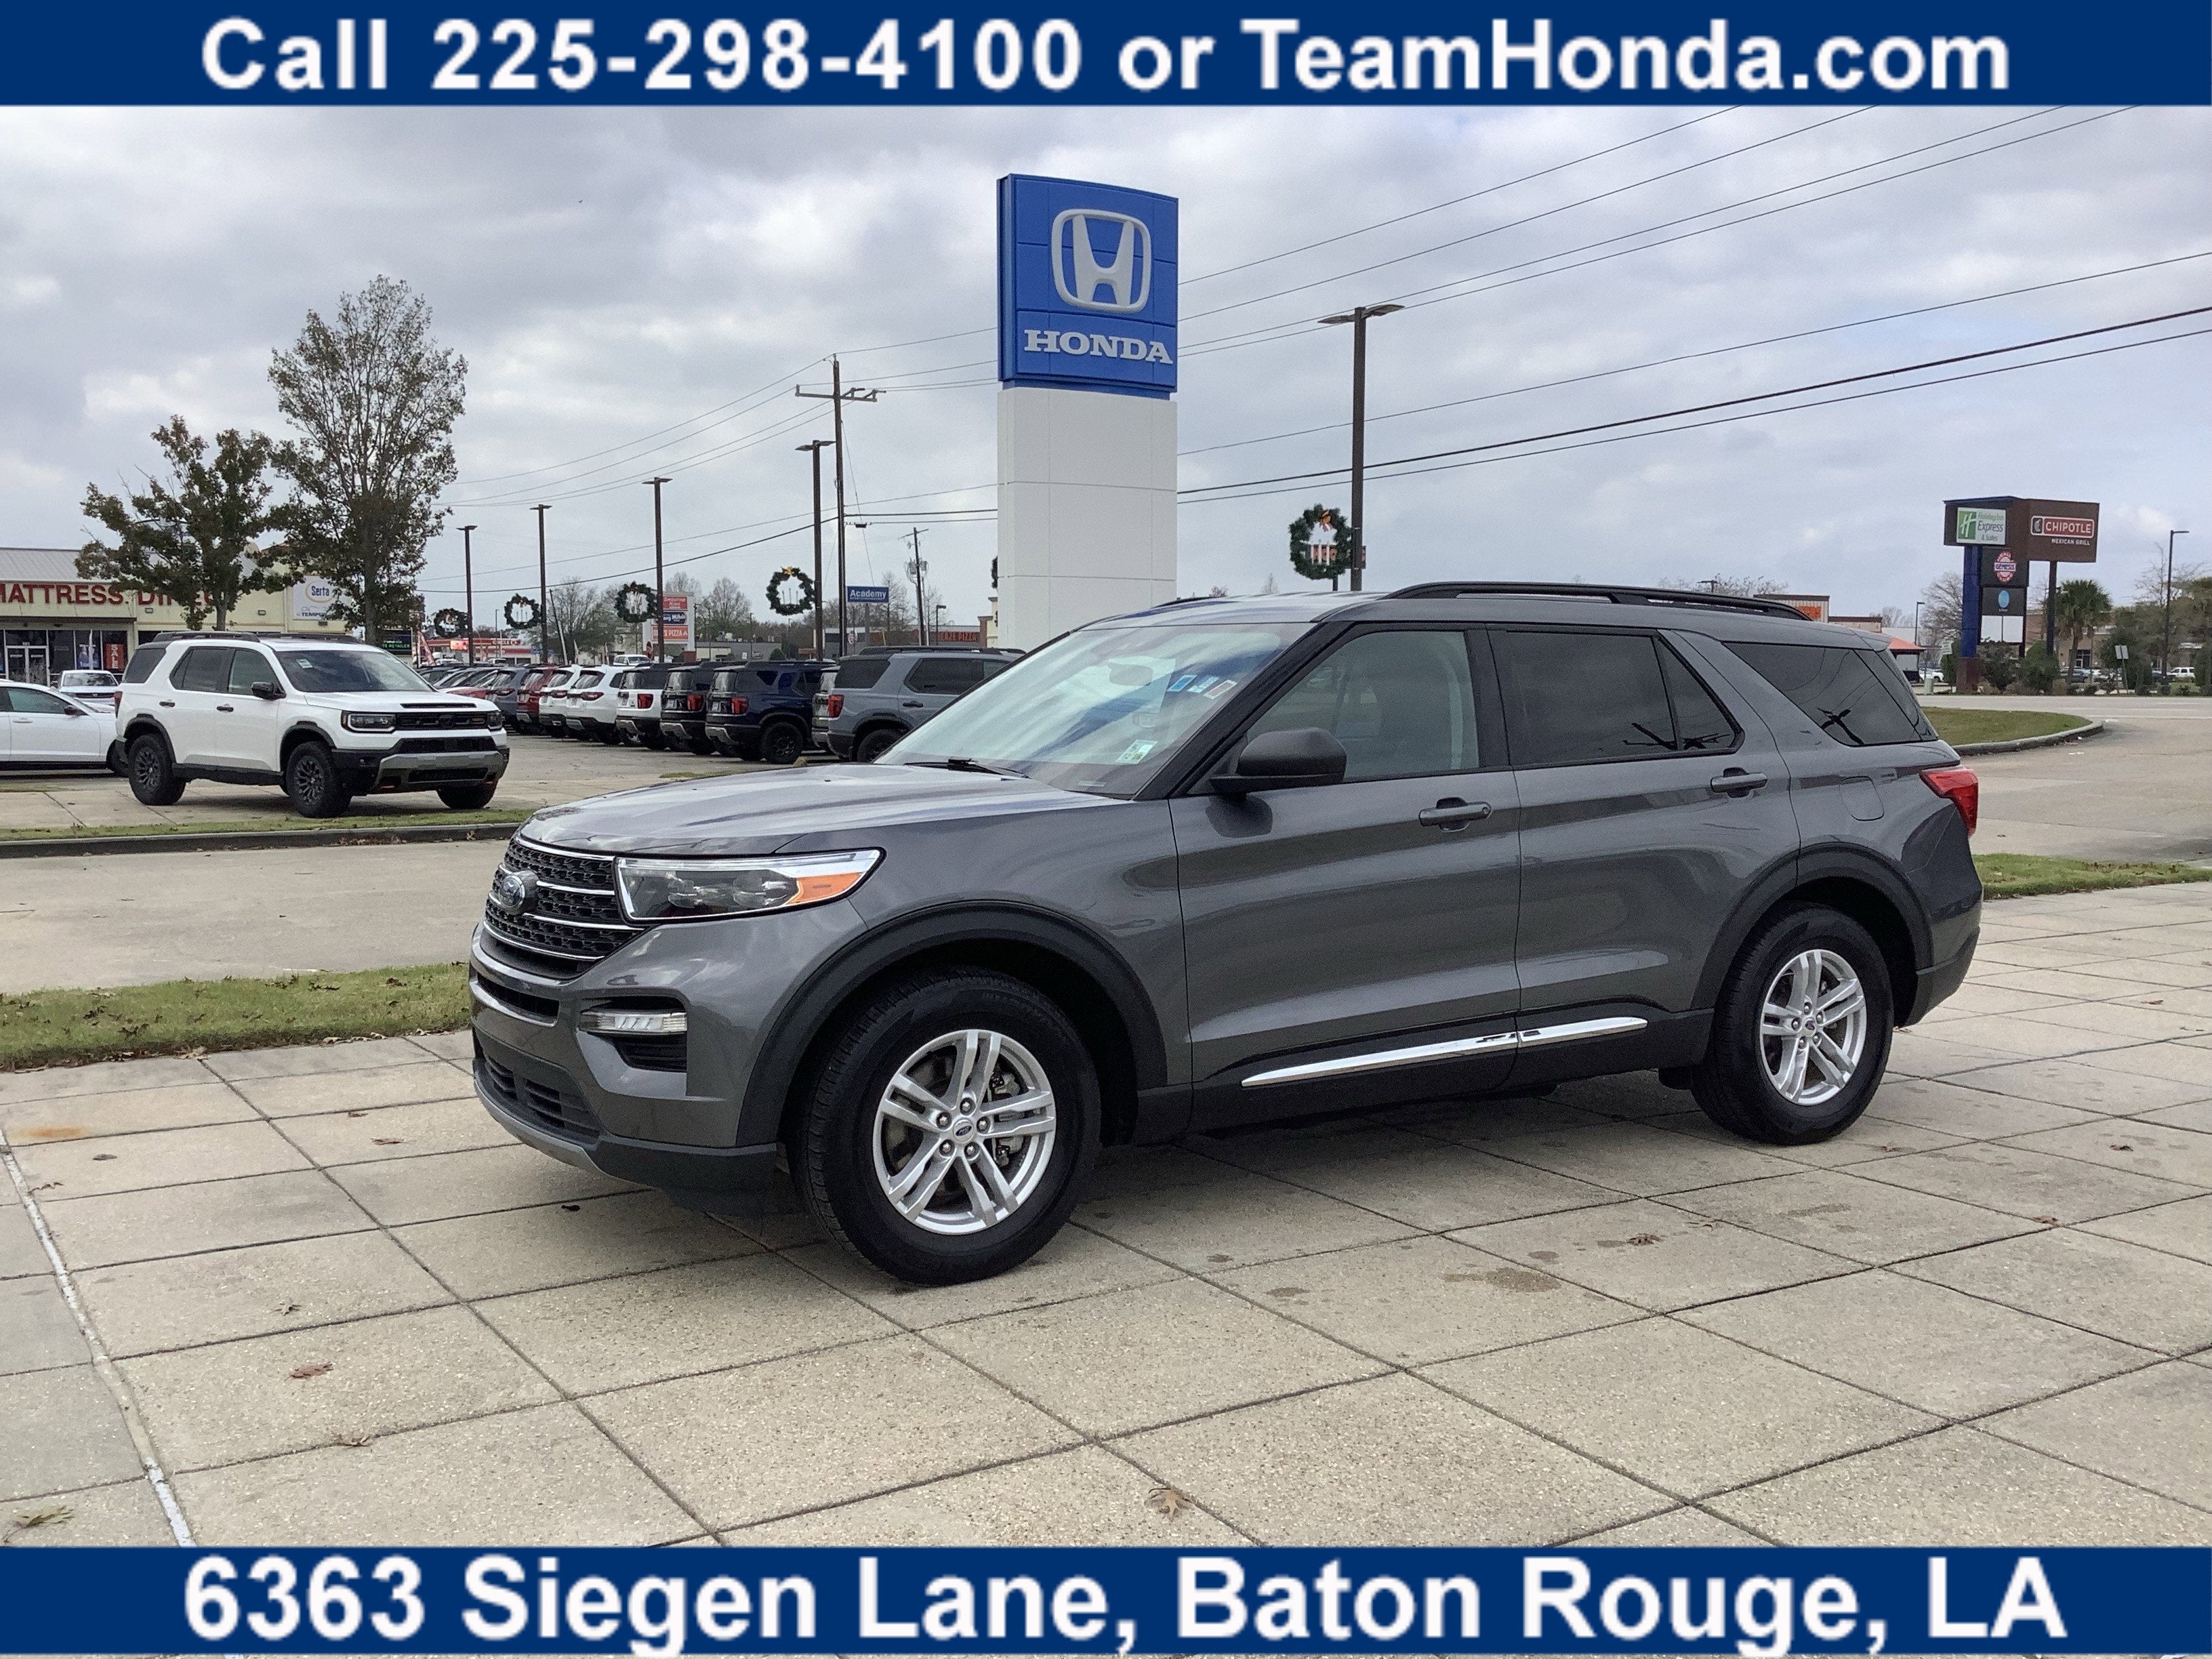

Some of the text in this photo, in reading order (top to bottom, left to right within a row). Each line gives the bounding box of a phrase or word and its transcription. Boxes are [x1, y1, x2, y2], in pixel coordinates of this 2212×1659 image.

[1024, 329, 1173, 365] HONDA
[1978, 520, 2003, 533] Express
[2045, 521, 2091, 533] CHIPOTLE
[311, 586, 329, 596] Serta
[850, 589, 886, 600] Academy
